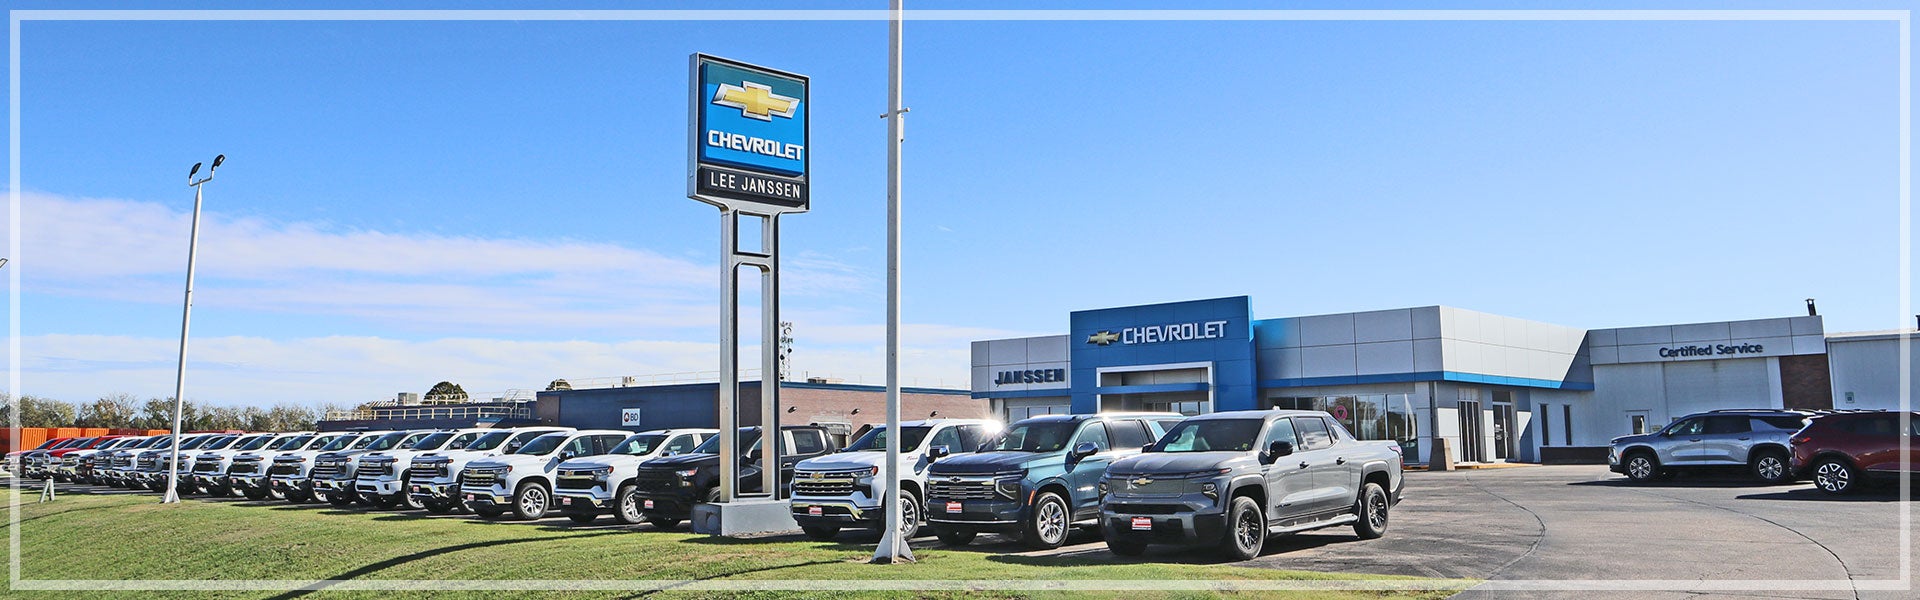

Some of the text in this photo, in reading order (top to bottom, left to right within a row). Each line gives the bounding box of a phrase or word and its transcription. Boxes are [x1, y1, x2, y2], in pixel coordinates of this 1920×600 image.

[708, 129, 804, 160] CHEVROLET
[710, 171, 800, 198] LEE JANSSEN
[1122, 320, 1227, 345] CHEVROLET
[1659, 342, 1763, 358] Certified Service
[994, 368, 1065, 386] JANSSEN
